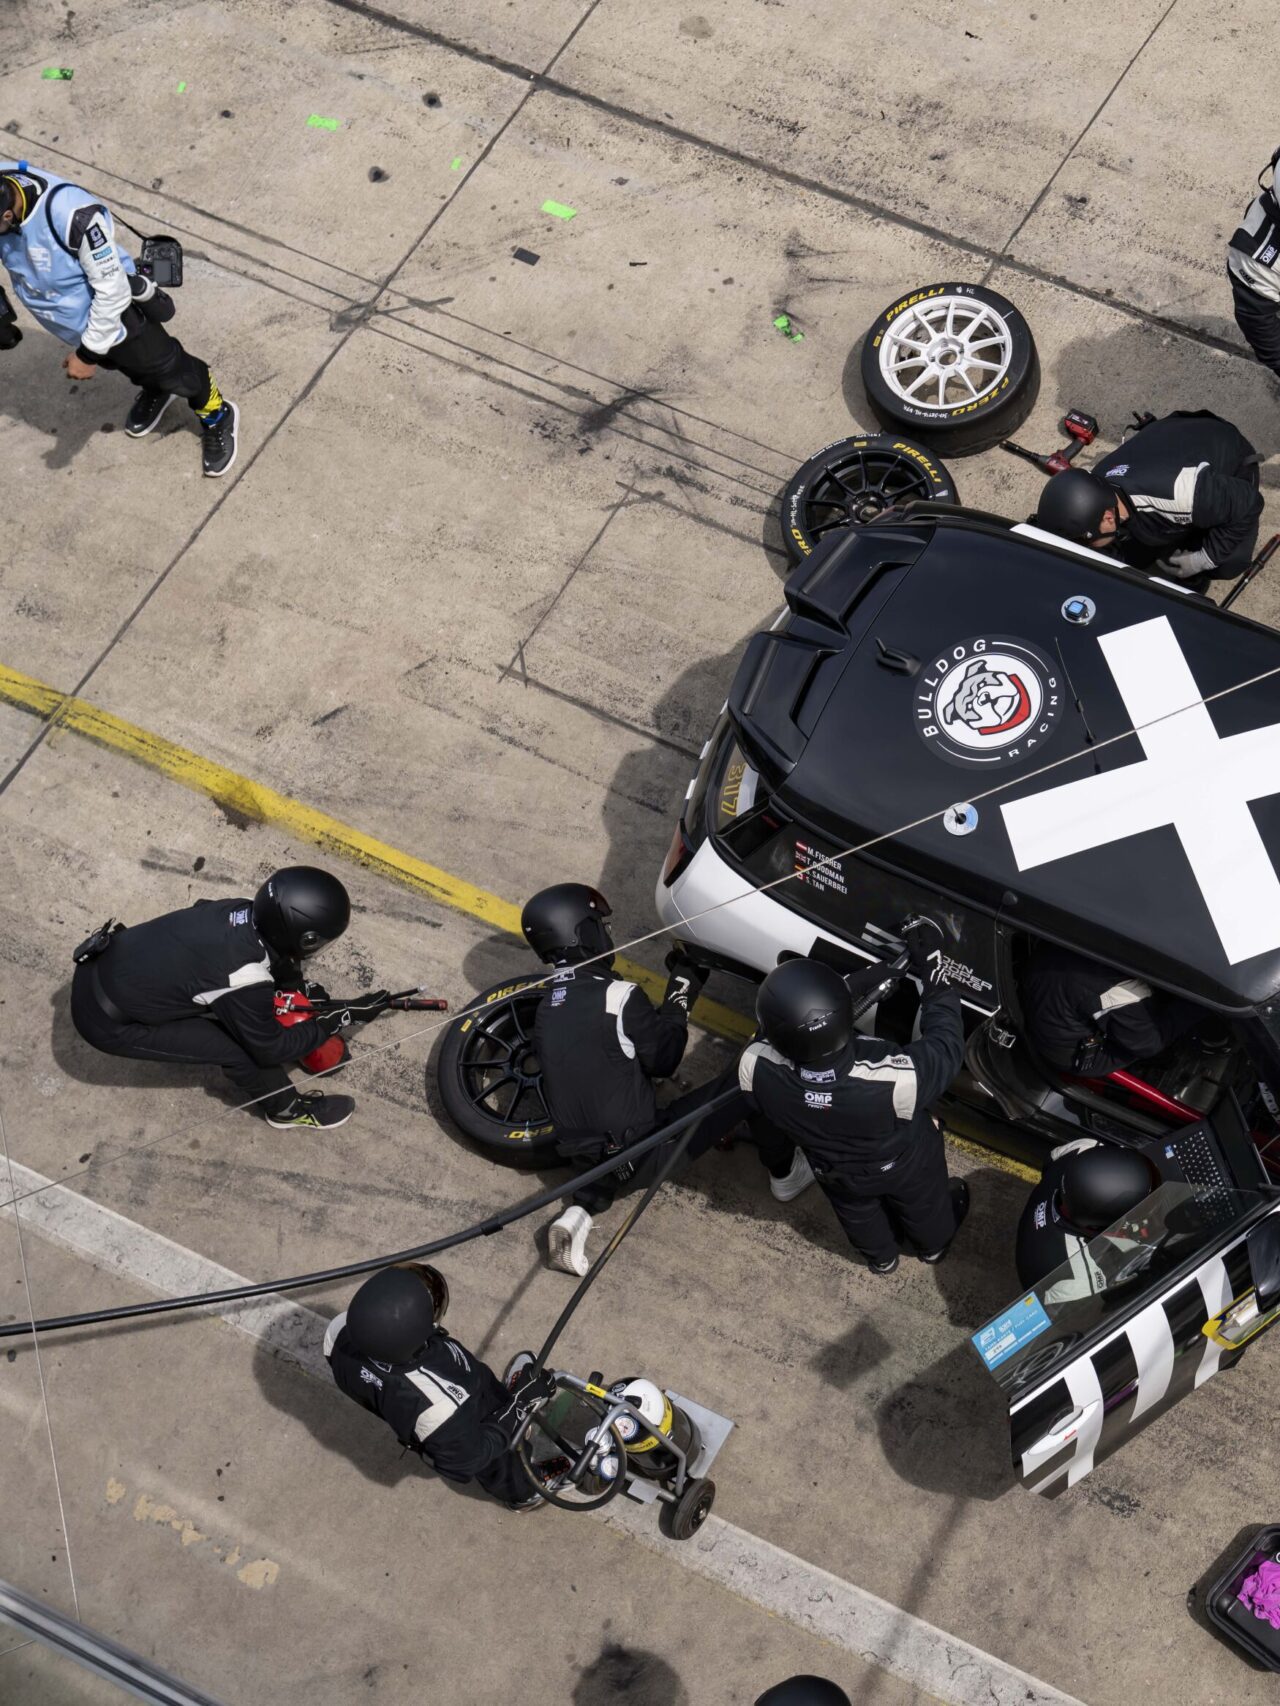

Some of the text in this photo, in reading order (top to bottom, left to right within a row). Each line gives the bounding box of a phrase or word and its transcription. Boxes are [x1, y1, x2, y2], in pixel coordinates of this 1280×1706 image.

[1262, 247, 1276, 263] OMP
[886, 287, 945, 321] PIRELLI
[893, 442, 942, 483] PIRELLI
[791, 528, 812, 556] ERO
[918, 639, 986, 738] BULLDOG
[1008, 677, 1058, 758] RACING
[804, 1091, 833, 1105] OMP
